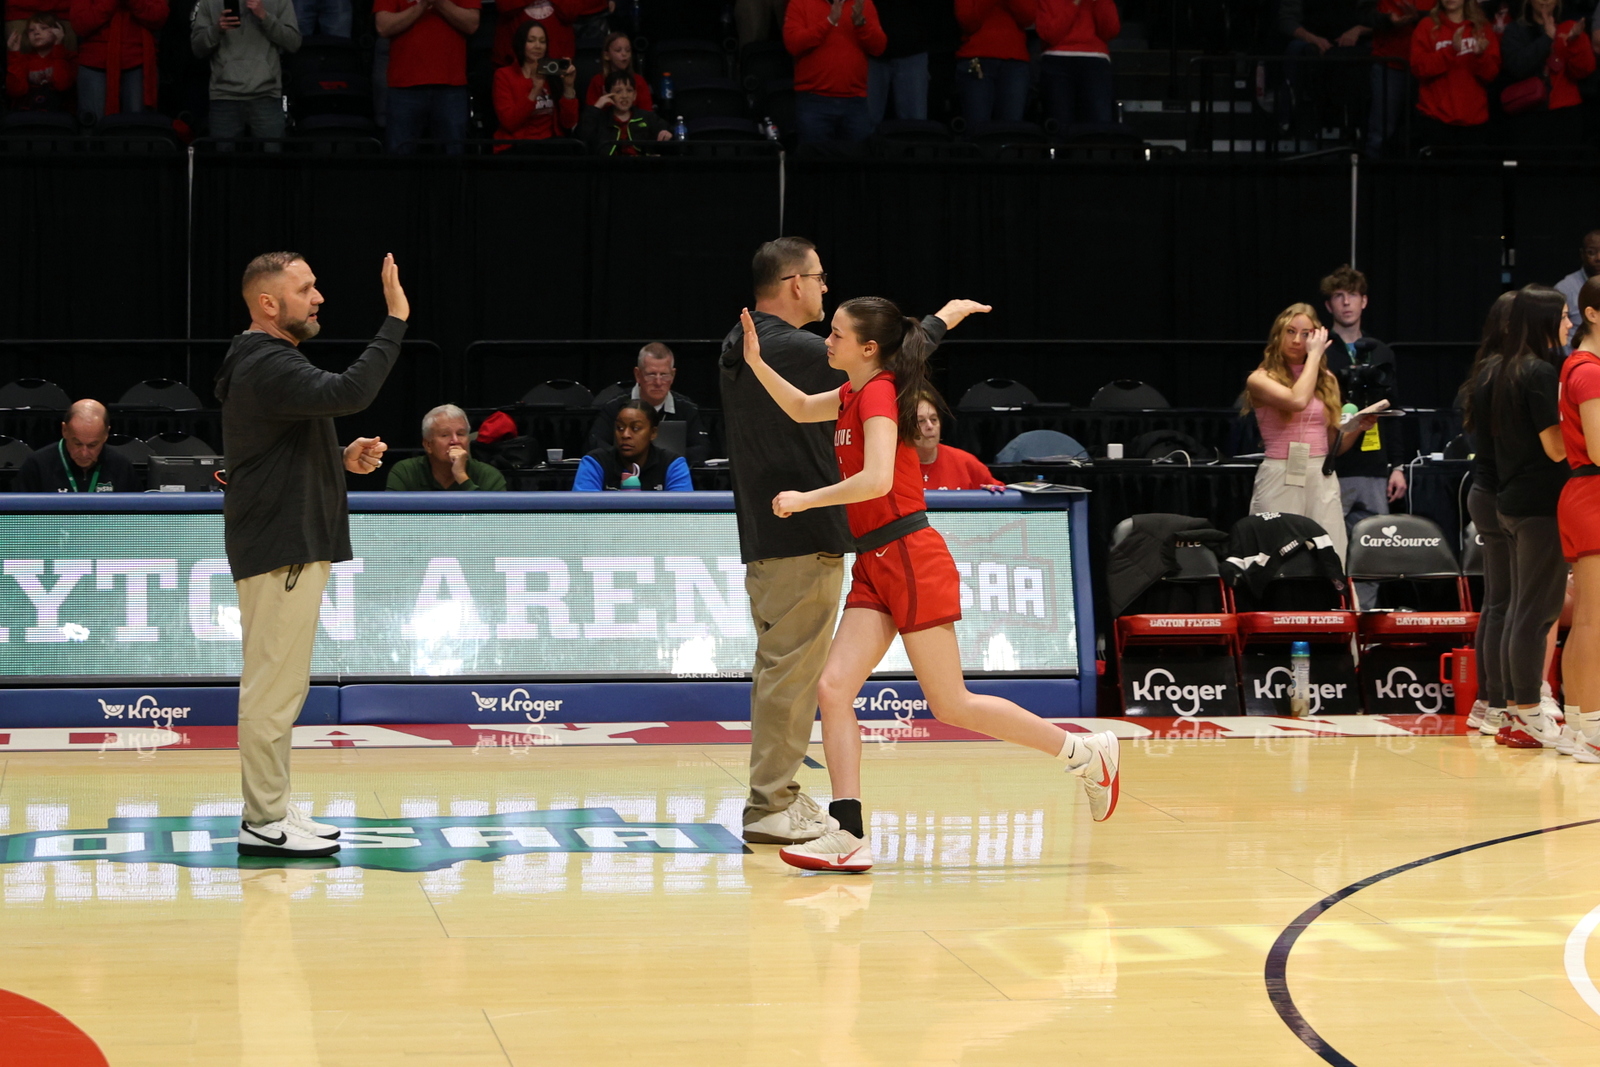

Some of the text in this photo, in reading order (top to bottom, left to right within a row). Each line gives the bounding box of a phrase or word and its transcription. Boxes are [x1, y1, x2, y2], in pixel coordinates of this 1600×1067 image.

[1360, 535, 1441, 547] CareSource
[401, 556, 748, 639] AREN
[1150, 618, 1222, 628] DAYTON FLYERS
[1273, 616, 1344, 625] DAYTON FLYERS
[1396, 617, 1466, 626] DAYTON FLYERS
[501, 688, 563, 722] Kroger
[1133, 668, 1226, 716] Kroger
[1375, 666, 1455, 714] Kroge
[128, 695, 191, 728] Kroger
